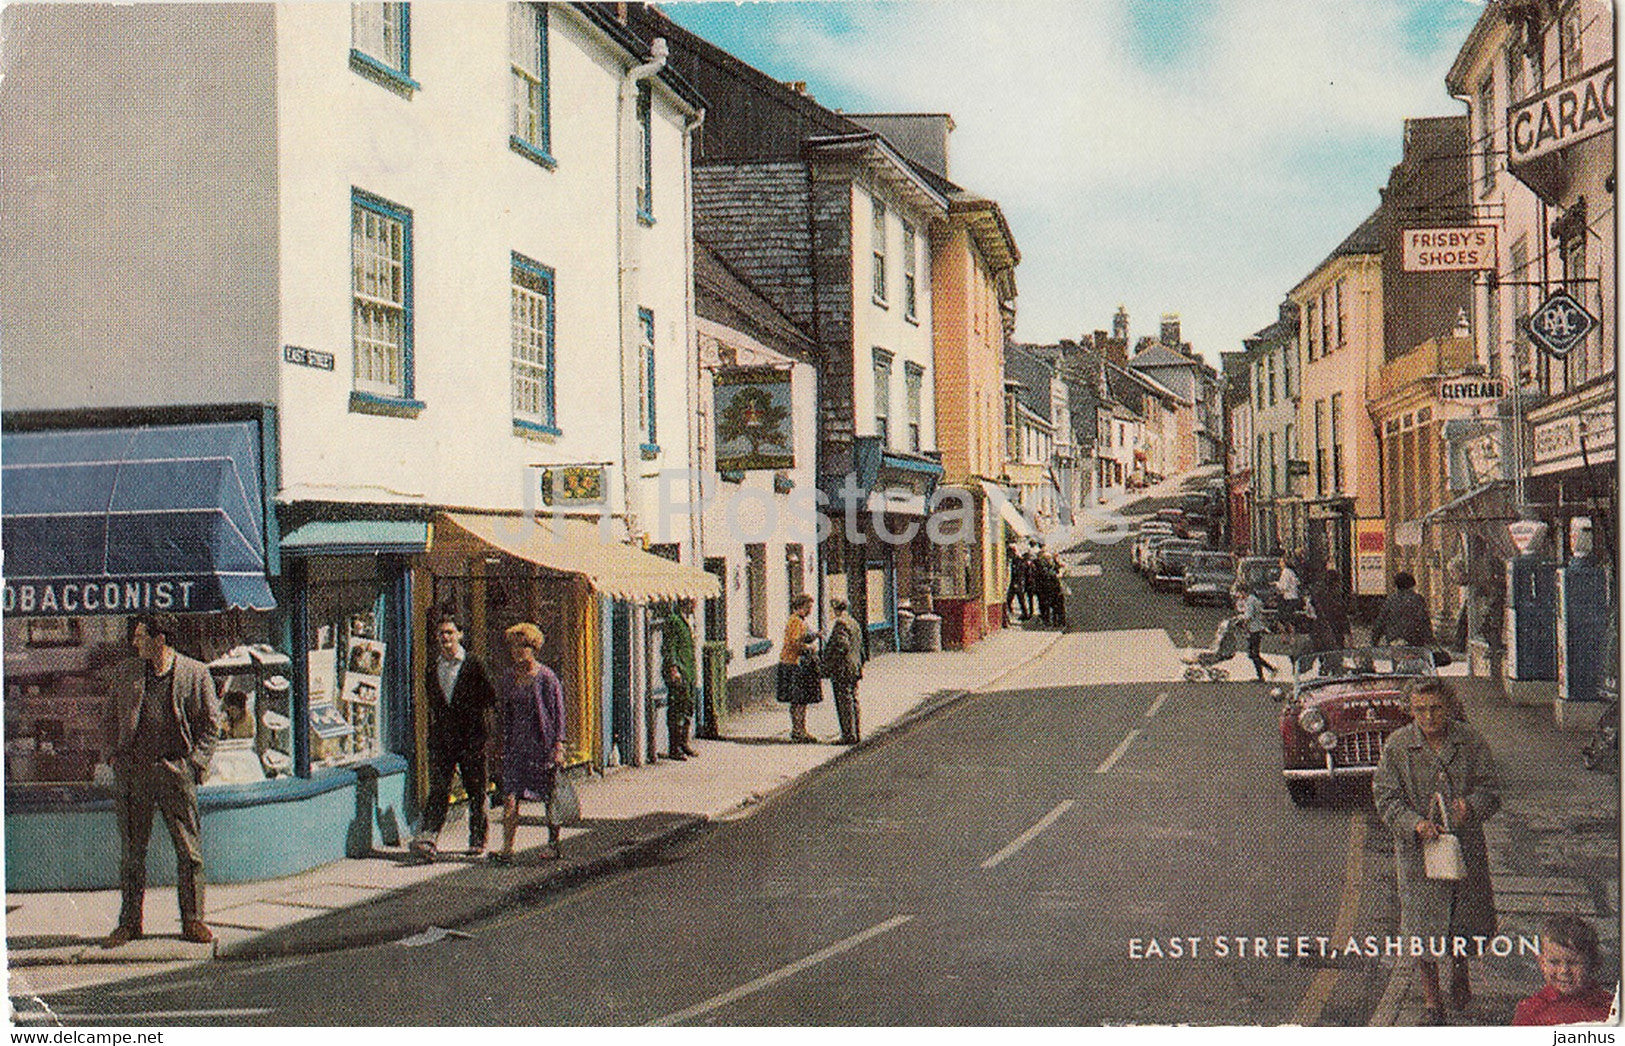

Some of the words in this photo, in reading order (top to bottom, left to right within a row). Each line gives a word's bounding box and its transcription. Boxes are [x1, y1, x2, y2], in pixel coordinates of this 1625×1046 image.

[1412, 231, 1487, 247] FRISBY'S
[1419, 249, 1479, 265] SHOES
[1543, 305, 1577, 335] RAC
[1442, 382, 1504, 399] CLEVELAND
